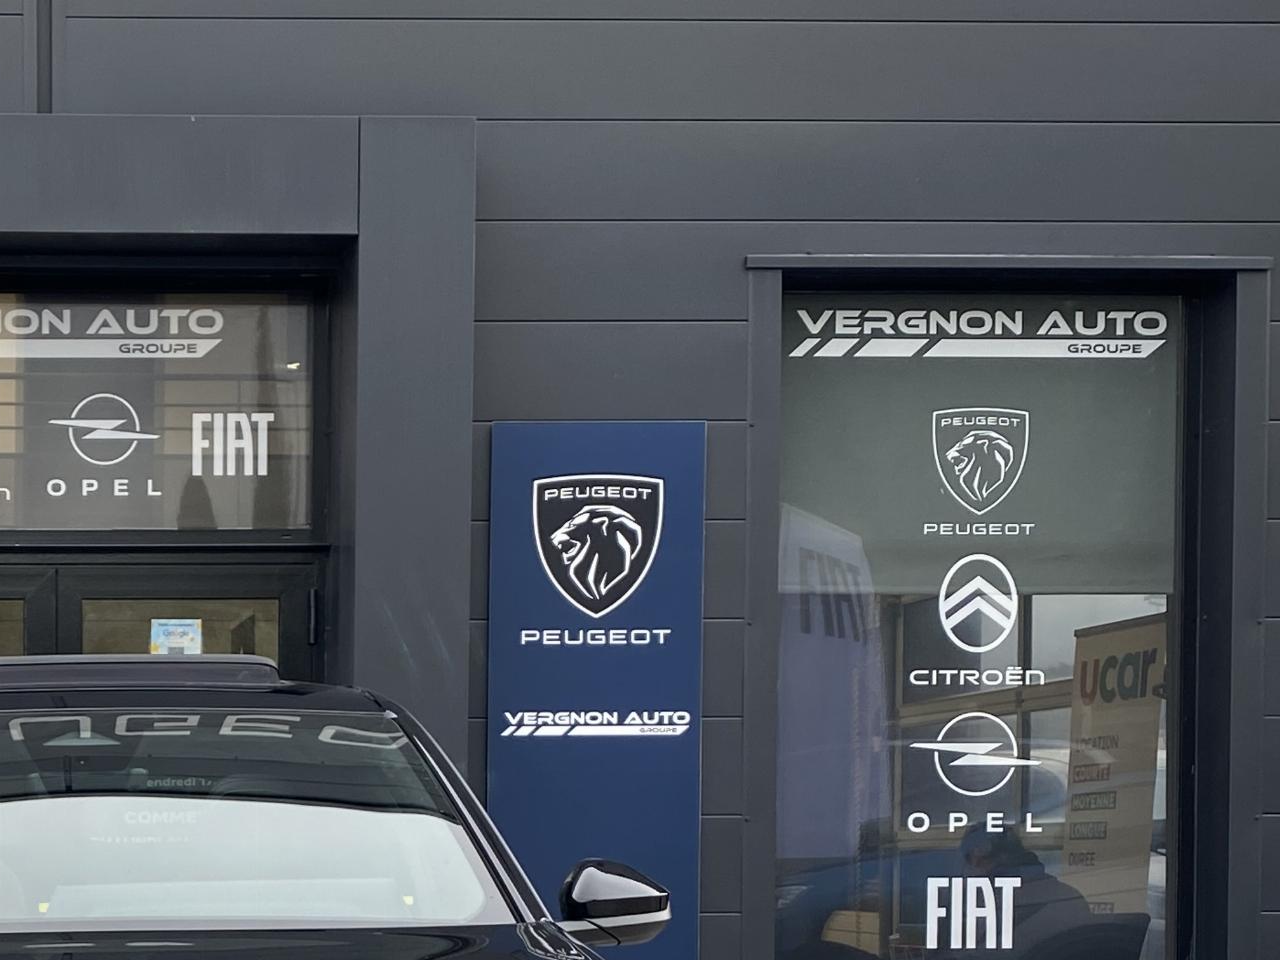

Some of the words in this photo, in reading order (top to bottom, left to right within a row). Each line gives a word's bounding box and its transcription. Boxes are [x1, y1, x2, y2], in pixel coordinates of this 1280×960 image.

[85, 308, 224, 335] AUTO
[796, 309, 1023, 335] VERGNON
[1036, 310, 1168, 336] AUTO
[118, 342, 198, 354] GROUPE
[1067, 343, 1143, 354] GROUPE
[940, 416, 1021, 427] PEUGEOT
[191, 413, 275, 476] FIAT
[46, 478, 162, 497] OPEL
[544, 486, 652, 500] PEUGEOT
[923, 523, 1036, 535] PEUGEOT
[520, 629, 671, 645] PEUGEOT
[504, 711, 618, 725] VERGNON
[624, 711, 691, 725] AUTO
[907, 812, 1042, 833] OPEL
[925, 877, 1022, 950] FIAT
